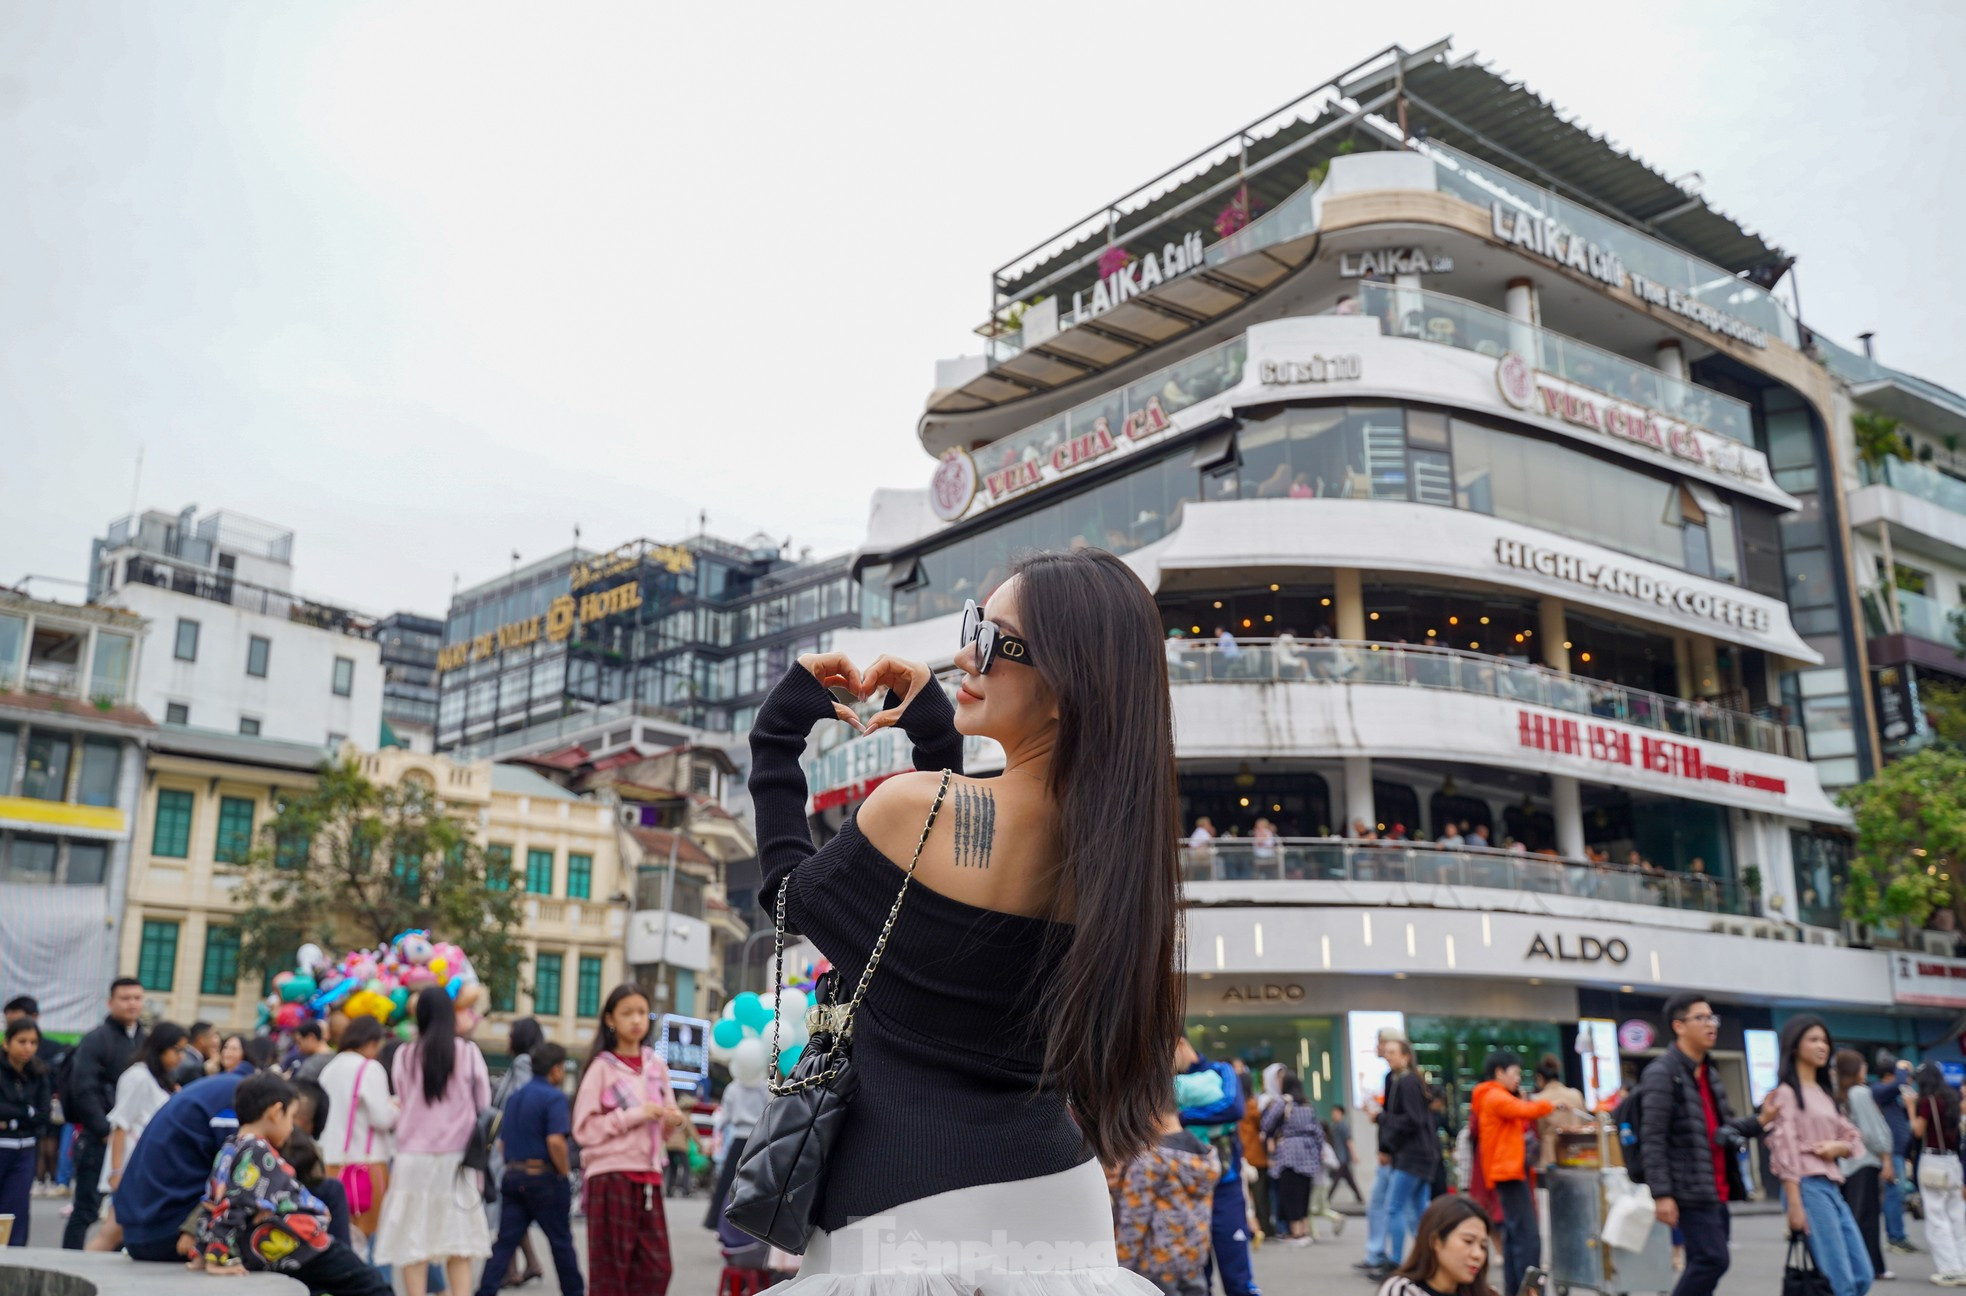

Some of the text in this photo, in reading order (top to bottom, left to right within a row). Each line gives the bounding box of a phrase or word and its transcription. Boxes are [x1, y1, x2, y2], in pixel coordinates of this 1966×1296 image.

[1491, 200, 1588, 274] LAIKA
[1072, 230, 1204, 323] LAIKA Café
[1340, 248, 1430, 278] LAIKA
[1537, 384, 1600, 429] VUA
[984, 457, 1042, 499] VUA
[580, 580, 643, 625] HOTEL
[1496, 537, 1771, 633] HIGHLANDS COFFEE
[1525, 932, 1630, 964] ALDO
[1222, 983, 1306, 1002] ALDO
